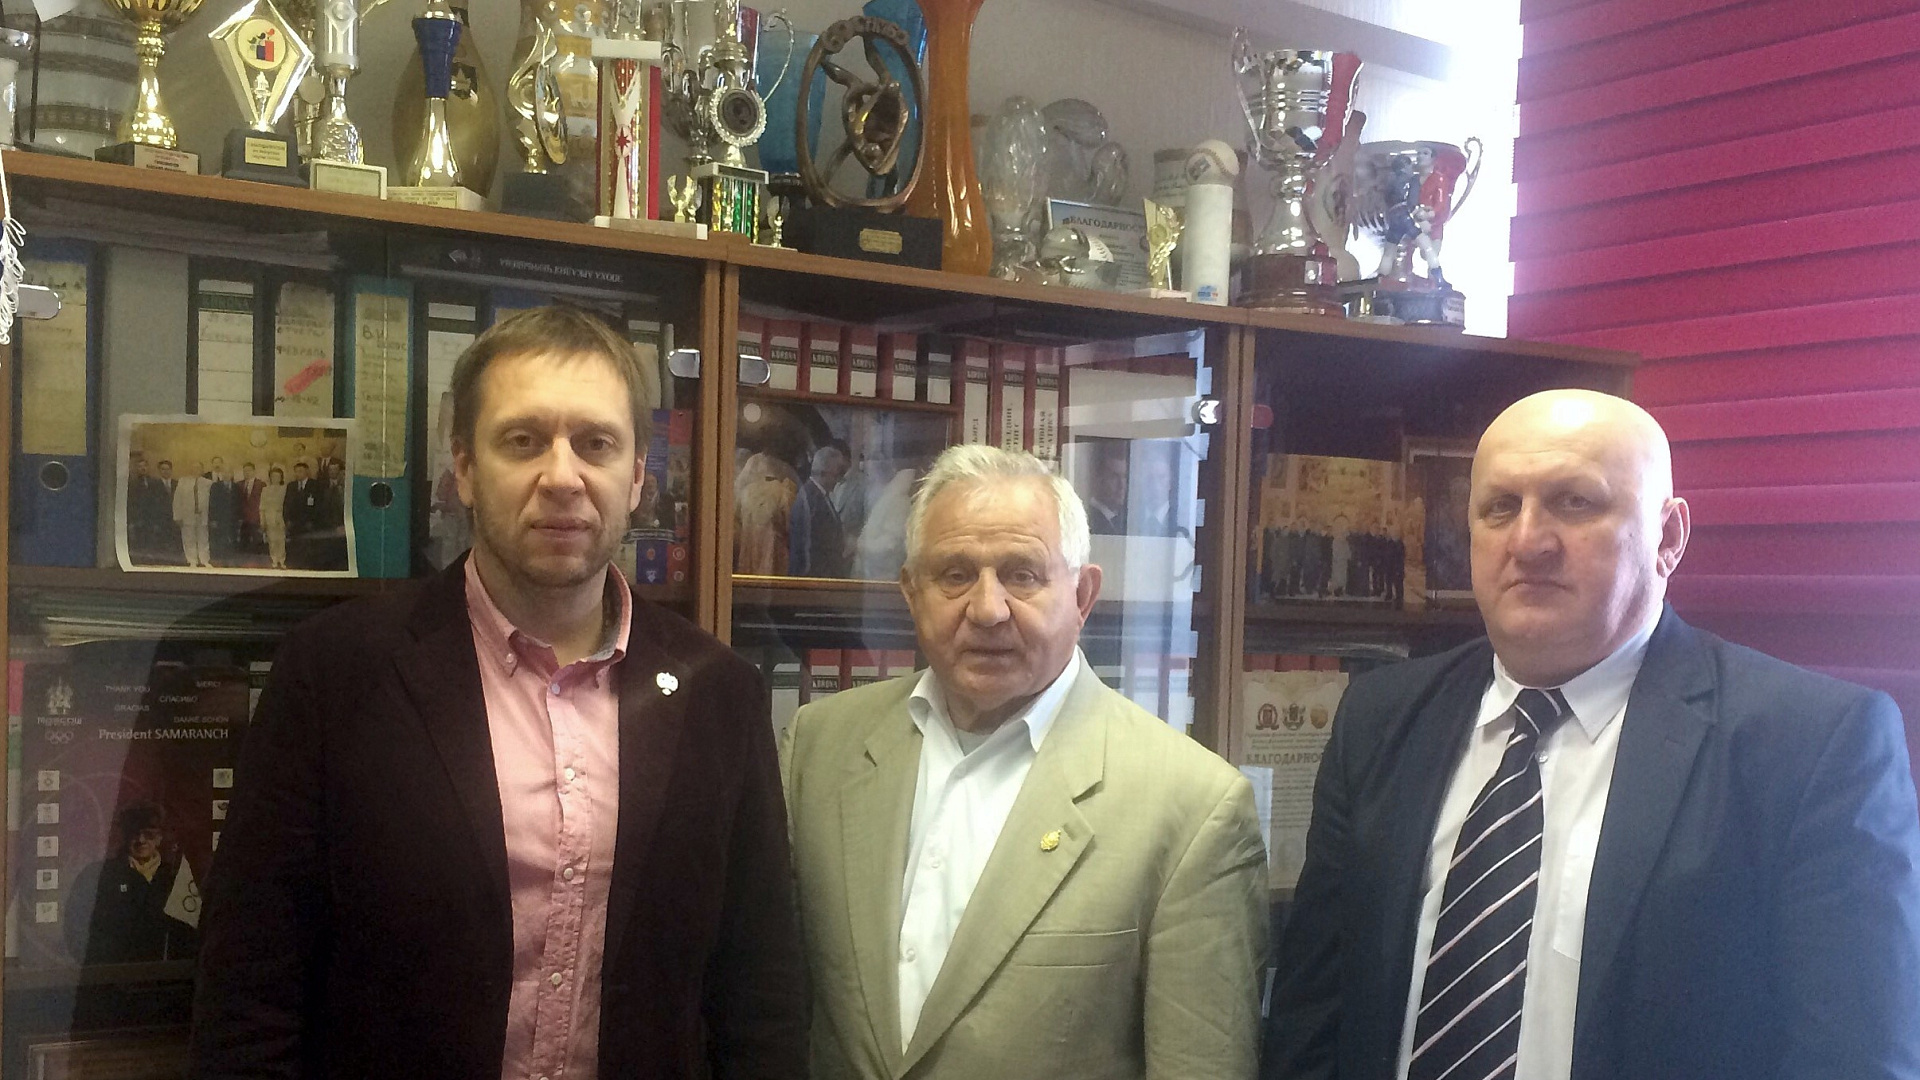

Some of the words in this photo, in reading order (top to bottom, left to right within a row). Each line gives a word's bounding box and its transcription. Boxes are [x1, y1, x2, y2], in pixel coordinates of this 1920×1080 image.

[98, 728, 152, 740] President
[154, 728, 229, 740] SAMARANCH
[1246, 752, 1321, 766] БЛАГОДАРНО
